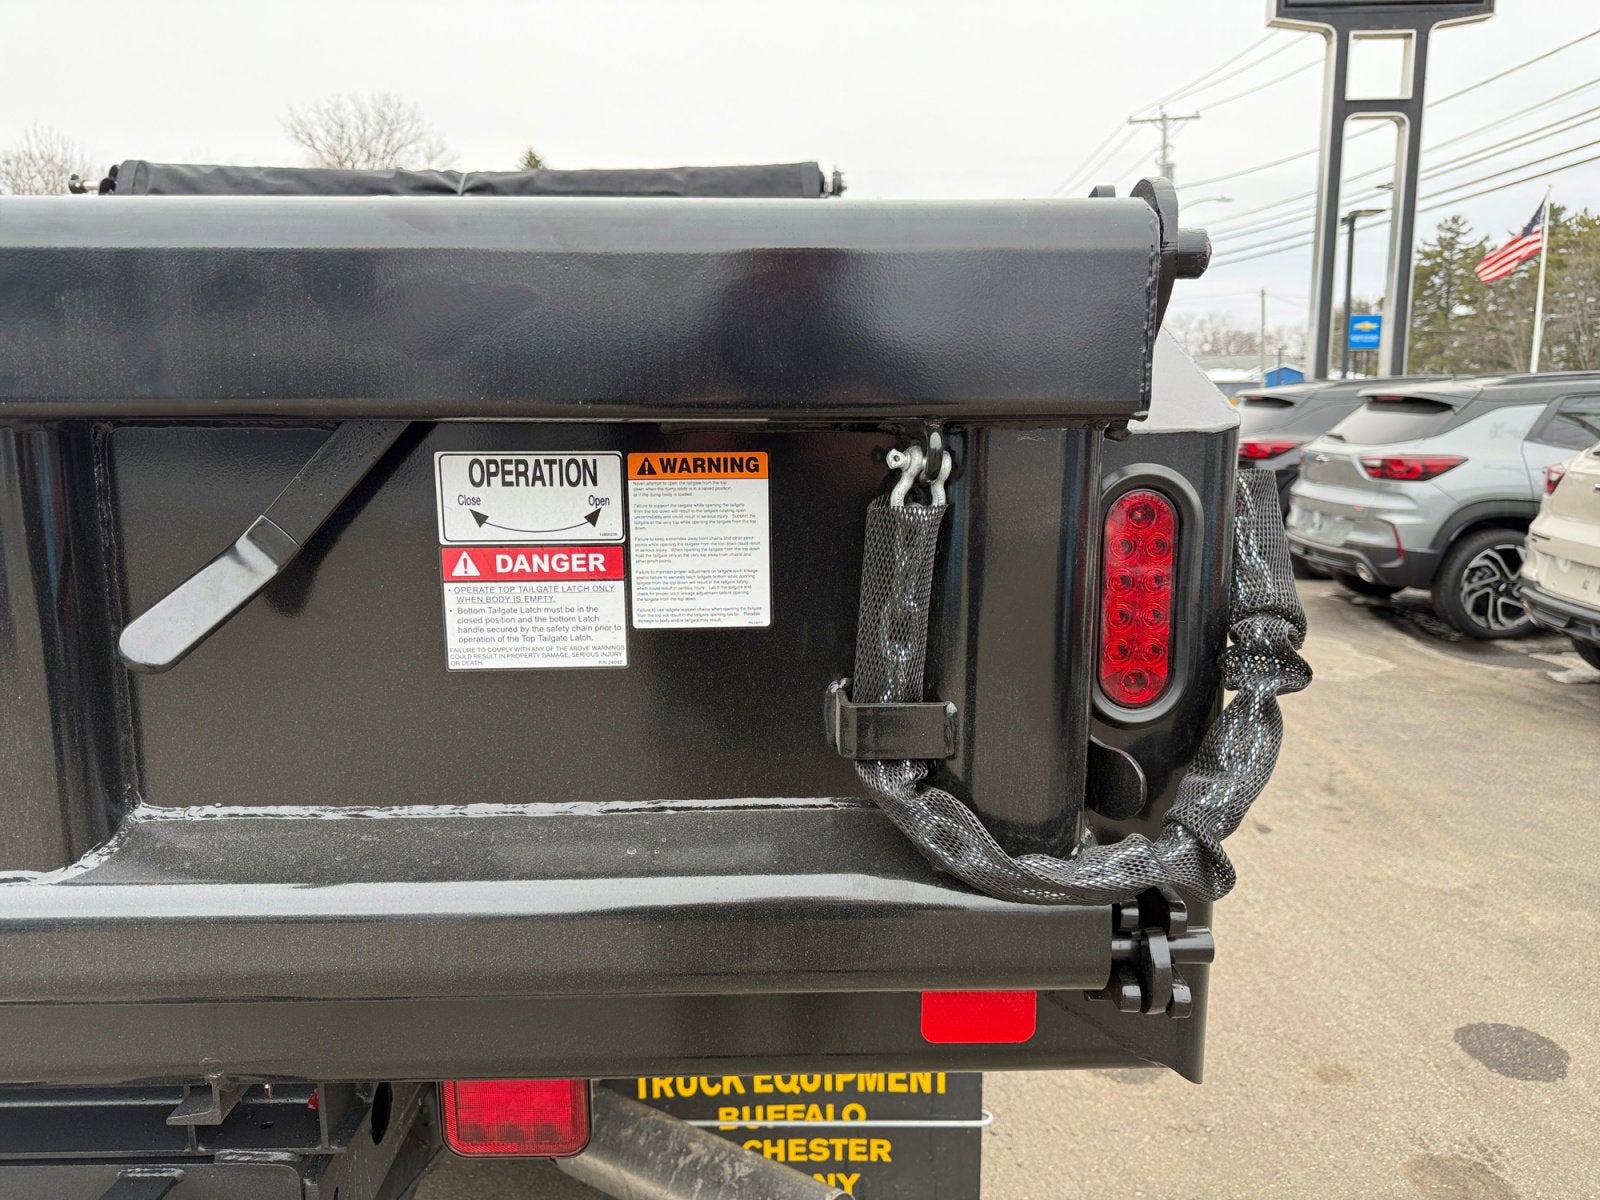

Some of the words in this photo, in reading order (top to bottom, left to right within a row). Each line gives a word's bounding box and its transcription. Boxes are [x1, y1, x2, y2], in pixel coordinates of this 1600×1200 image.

[660, 457, 759, 473] WARNING
[469, 458, 598, 487] OPERATION
[458, 495, 481, 505] Close
[589, 495, 609, 508] Open
[496, 554, 606, 572] DANGER
[454, 586, 495, 594] OPERATE
[489, 607, 517, 615] Tailgate
[485, 617, 514, 625] position
[520, 626, 529, 634] by
[595, 625, 611, 633] prior
[458, 636, 495, 644] operation
[522, 635, 535, 643] Top
[539, 635, 567, 643] Tailgate
[637, 1075, 745, 1099] TRUCK
[753, 1072, 946, 1095] EQUIPMENT
[718, 1103, 867, 1130] BUFFALO
